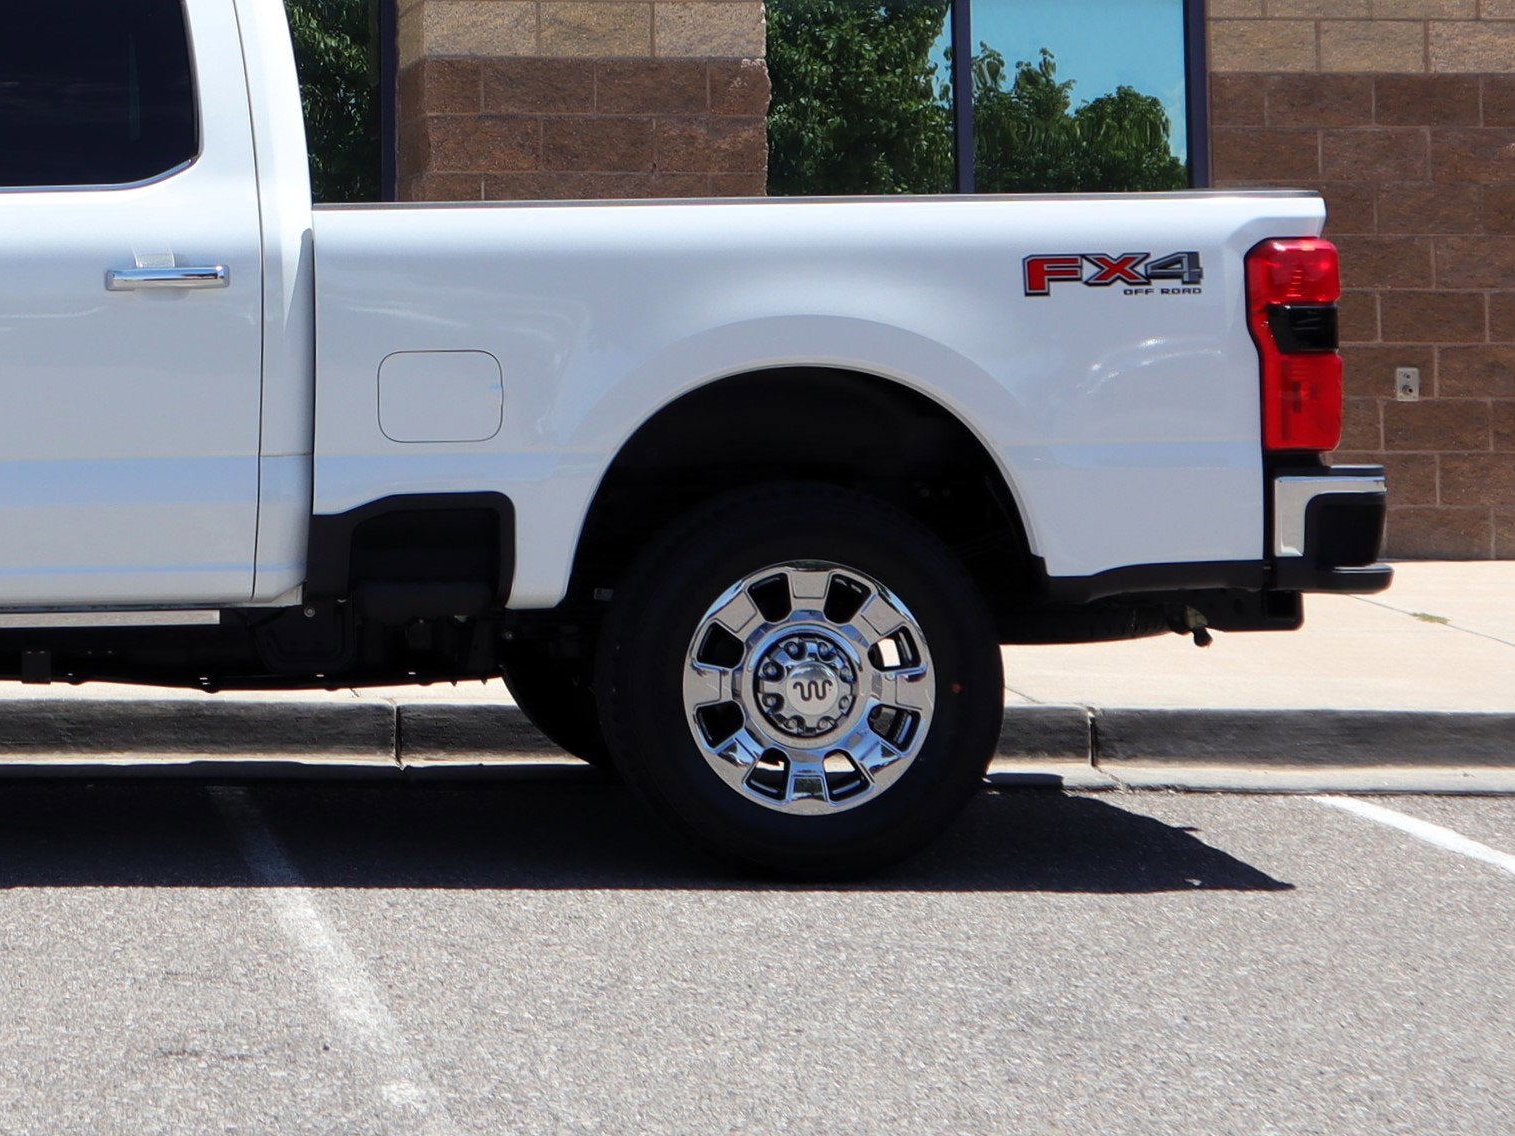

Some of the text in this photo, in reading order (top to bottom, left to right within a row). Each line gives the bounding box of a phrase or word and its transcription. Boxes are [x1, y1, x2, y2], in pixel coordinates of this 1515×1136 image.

[1022, 251, 1204, 297] FX4
[1123, 287, 1202, 296] OFF ROAD
